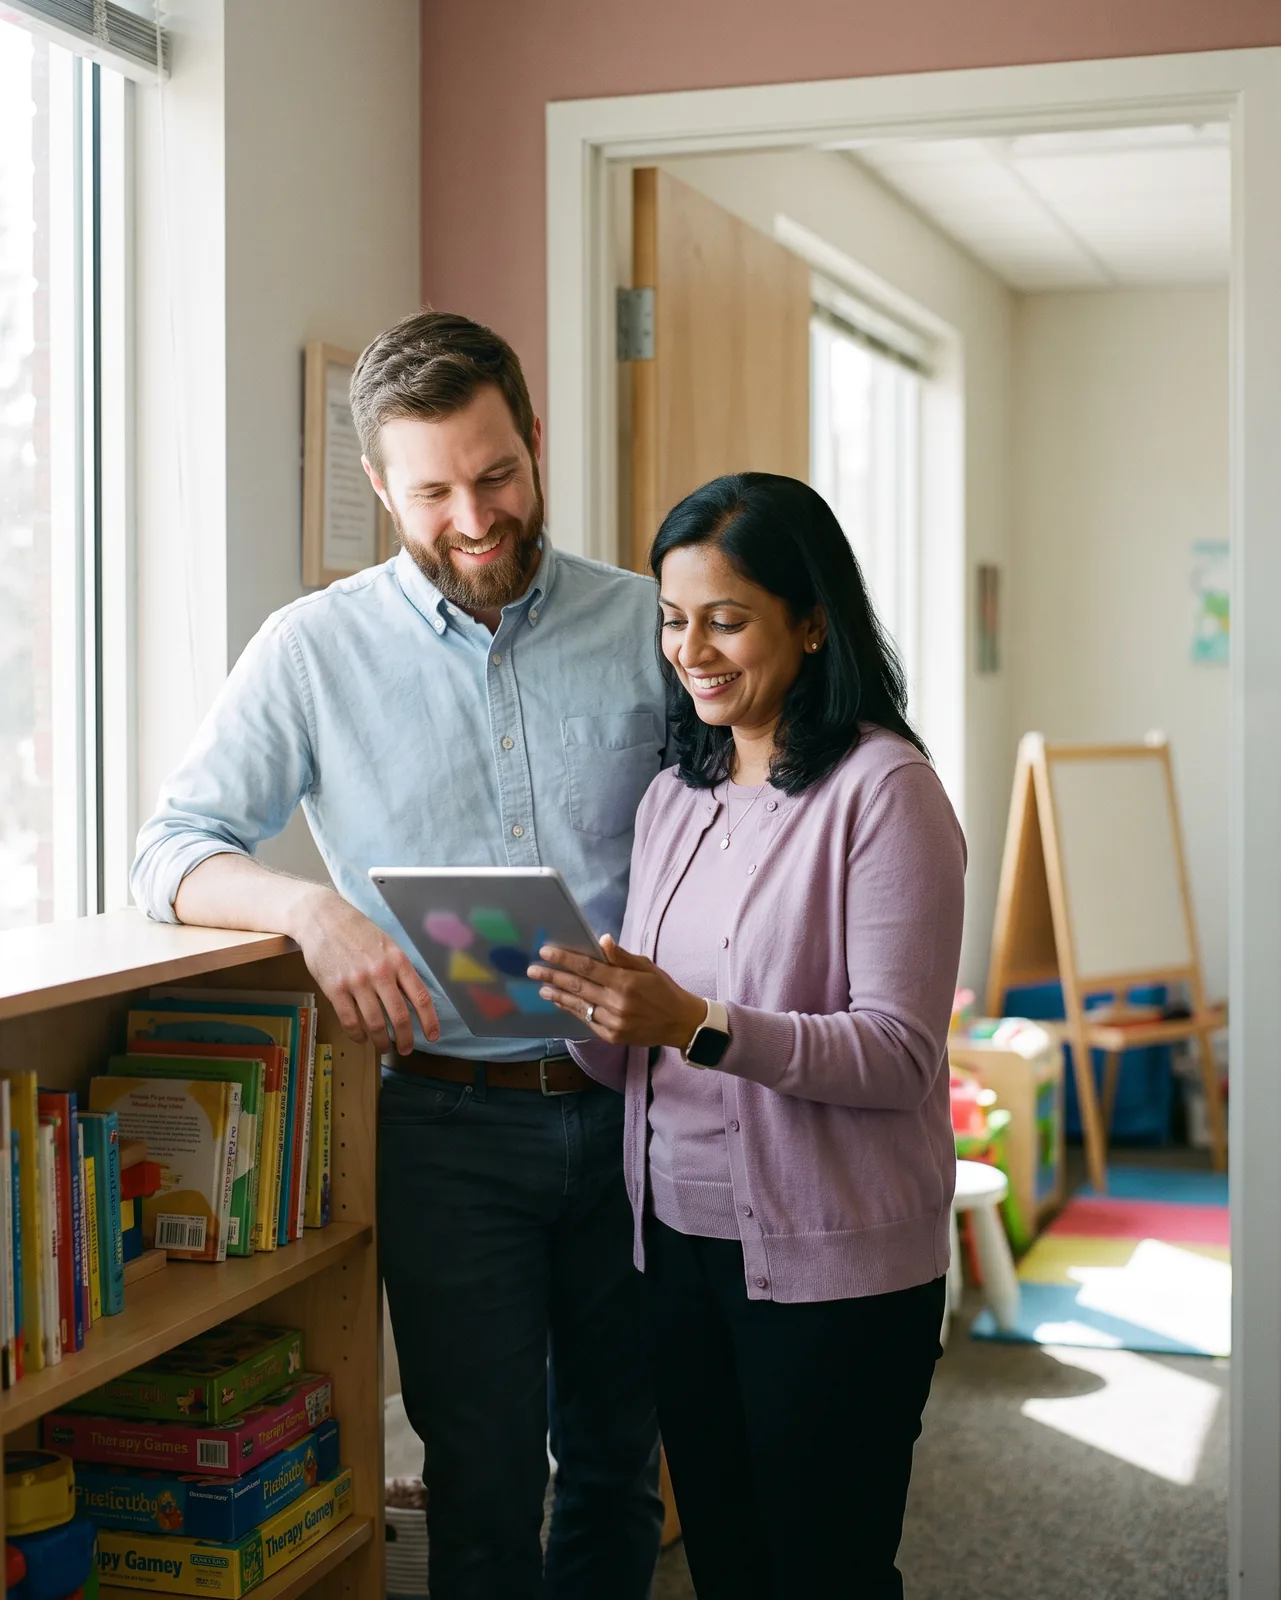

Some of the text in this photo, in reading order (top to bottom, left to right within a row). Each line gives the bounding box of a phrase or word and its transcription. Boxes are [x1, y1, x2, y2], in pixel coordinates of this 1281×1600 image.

[90, 1432, 143, 1451] Therapy
[144, 1437, 189, 1454] Games
[258, 1423, 285, 1446] Therapy
[265, 1520, 303, 1558] Therapy
[304, 1498, 335, 1530] Gamey
[125, 1550, 183, 1578] Gamey
